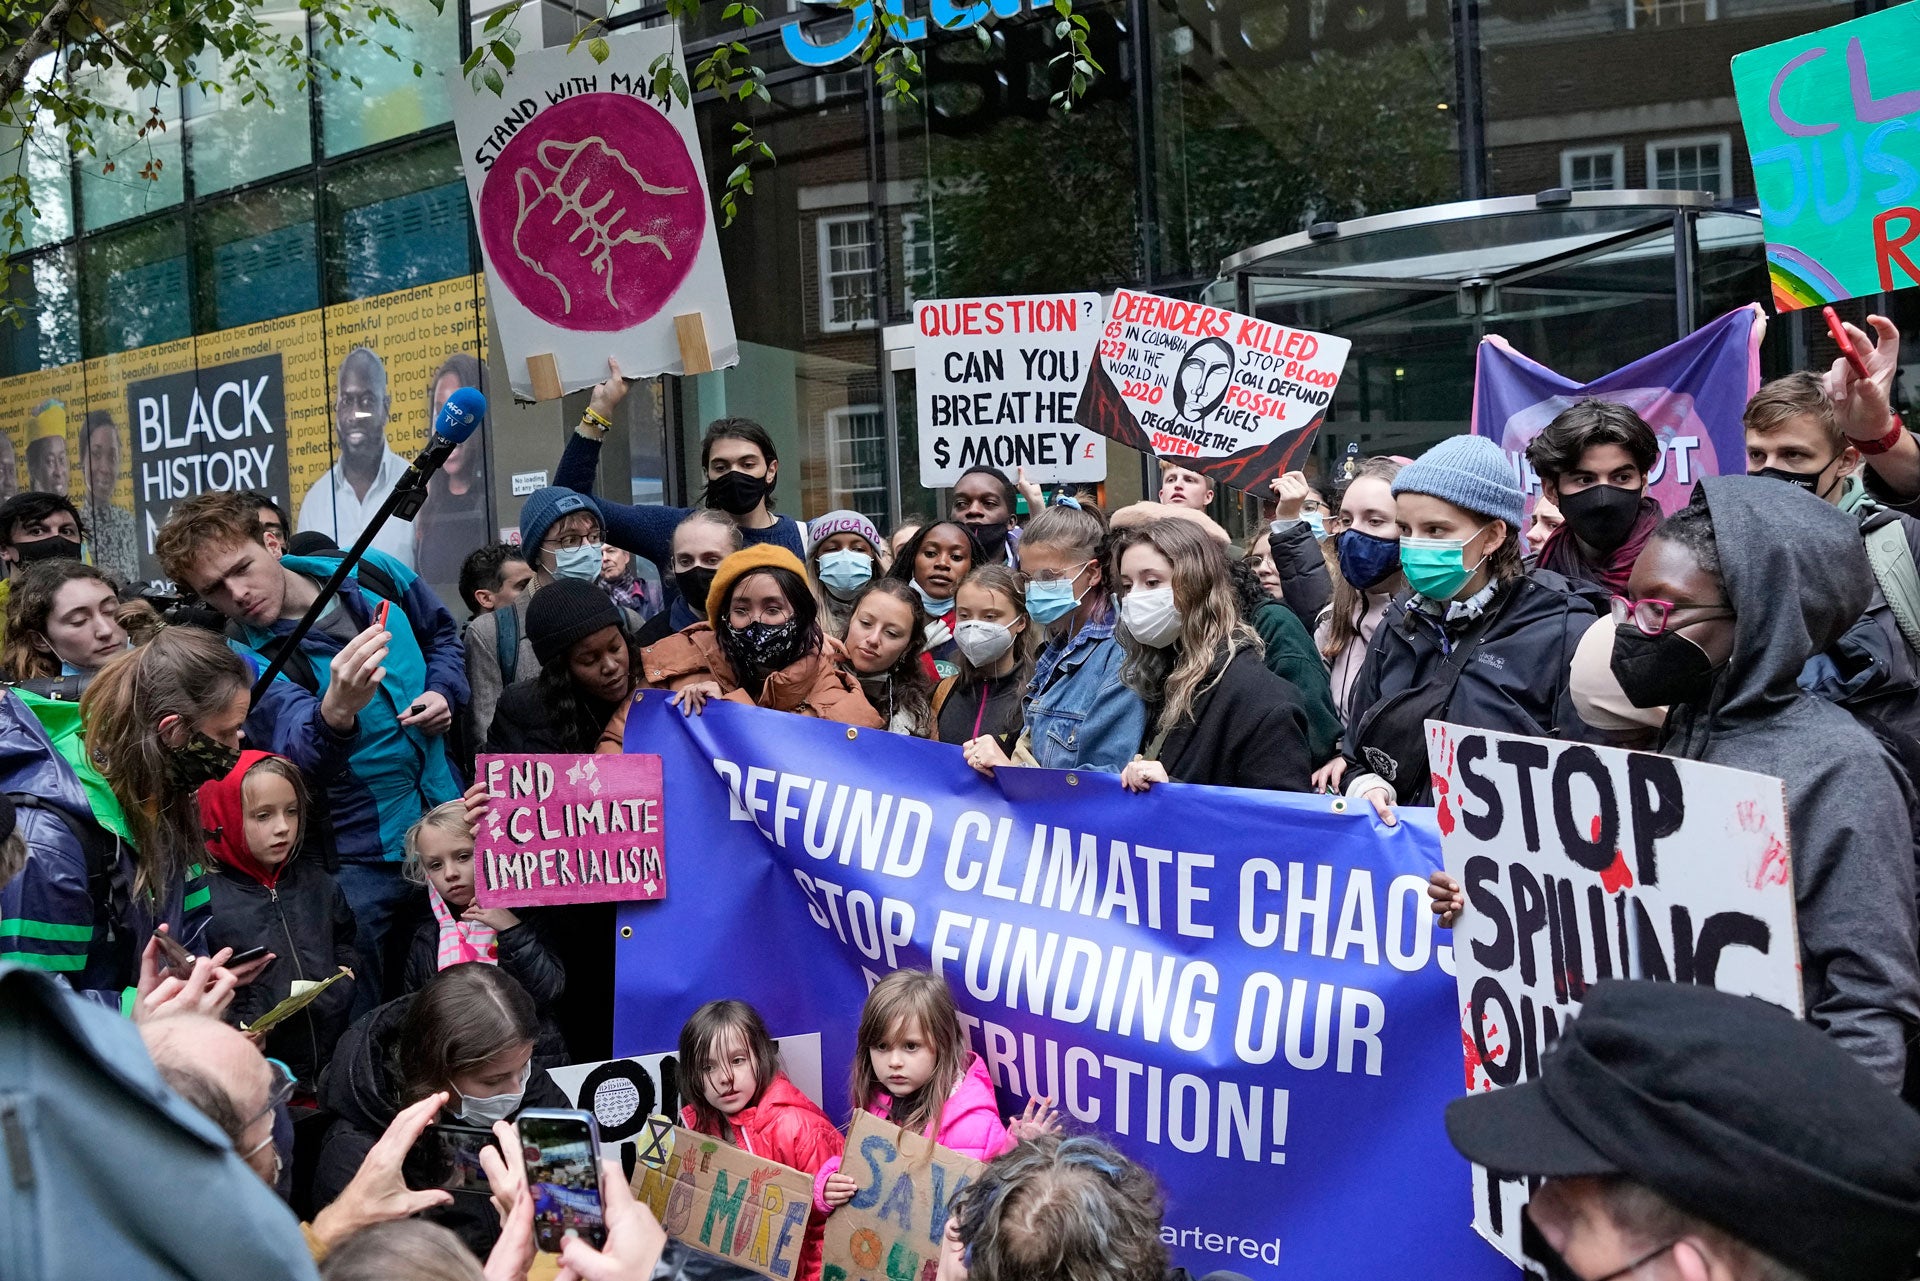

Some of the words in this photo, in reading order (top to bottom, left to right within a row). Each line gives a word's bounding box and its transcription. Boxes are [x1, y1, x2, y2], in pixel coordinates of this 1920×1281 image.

[475, 98, 538, 172] STAND
[545, 75, 597, 105] WITH
[79, 360, 100, 373] sster
[128, 351, 137, 362] to
[139, 348, 150, 360] be
[151, 348, 157, 357] a
[159, 340, 191, 355] brother
[196, 334, 220, 348] proud
[222, 330, 232, 342] to
[234, 328, 246, 340] be
[248, 317, 296, 337] ambitious
[333, 307, 344, 318] to
[347, 301, 360, 315] be
[362, 285, 433, 311] independent
[438, 273, 473, 297] proud
[1105, 320, 1122, 339] 65
[1125, 325, 1140, 341] IN
[1142, 328, 1188, 354] COLOMBIA
[1112, 291, 1232, 337] DEFENDERS
[1236, 317, 1319, 362] KILLED
[51, 381, 72, 396] equal
[121, 362, 159, 380] beautiful
[162, 355, 188, 373] proud
[201, 352, 212, 364] be
[214, 352, 220, 361] a
[222, 345, 240, 360] role
[242, 337, 272, 356] model
[276, 331, 304, 351] proud
[306, 331, 317, 342] to
[336, 314, 382, 336] thankful
[386, 306, 419, 330] proud
[421, 306, 433, 319] to
[436, 301, 451, 316] be
[454, 302, 462, 312] a
[288, 348, 316, 366] proud
[333, 342, 346, 355] be
[383, 326, 416, 349] proud
[418, 327, 431, 340] to
[433, 322, 448, 337] be
[394, 345, 426, 367] proud
[429, 344, 441, 358] to
[444, 338, 459, 355] be
[1127, 347, 1139, 362] IN
[1143, 349, 1165, 369] THE
[285, 366, 307, 383] roud
[309, 368, 320, 380] to
[394, 364, 427, 388] proud
[944, 348, 1004, 384] CAN
[1020, 348, 1079, 383] YOU
[1109, 359, 1151, 384] WORLD
[1155, 372, 1170, 388] IN
[1240, 350, 1284, 373] STOP
[1284, 361, 1338, 388] BLOOD
[70, 386, 119, 406] insprational
[286, 386, 308, 402] roud
[310, 386, 321, 398] to
[395, 391, 407, 403] to
[409, 386, 424, 401] be
[1121, 379, 1164, 406] 2020
[1225, 384, 1286, 421] FOSSIL
[1234, 368, 1264, 391] COAL
[1267, 377, 1330, 407] DEFUND
[139, 374, 273, 453] BLACK
[445, 415, 458, 427] TV
[446, 401, 463, 416] AFP
[931, 391, 1077, 426] BREATHE
[1214, 405, 1261, 433] FUELS
[297, 421, 326, 438] proud
[396, 429, 411, 442] be
[1141, 410, 1212, 448] DECOLONIZE
[1212, 433, 1238, 453] THE
[959, 432, 1081, 469] MONEY
[143, 444, 274, 502] HISTORY
[524, 475, 544, 484] loading
[813, 519, 880, 544] CHICAGO
[485, 759, 555, 802] END
[507, 799, 658, 845] CLIMATE
[1456, 735, 1685, 887] STOP
[713, 758, 934, 879] DEFUND
[944, 809, 1215, 939] CLIMATE
[483, 846, 663, 891] IMPERIALISM
[793, 868, 916, 970] STOP
[931, 910, 1220, 1052] FUNDING
[1234, 970, 1386, 1077] OUR
[850, 1135, 971, 1246] SAV
[638, 1153, 696, 1236] NO
[699, 1168, 808, 1278] MORE
[1158, 1224, 1281, 1267] artered
